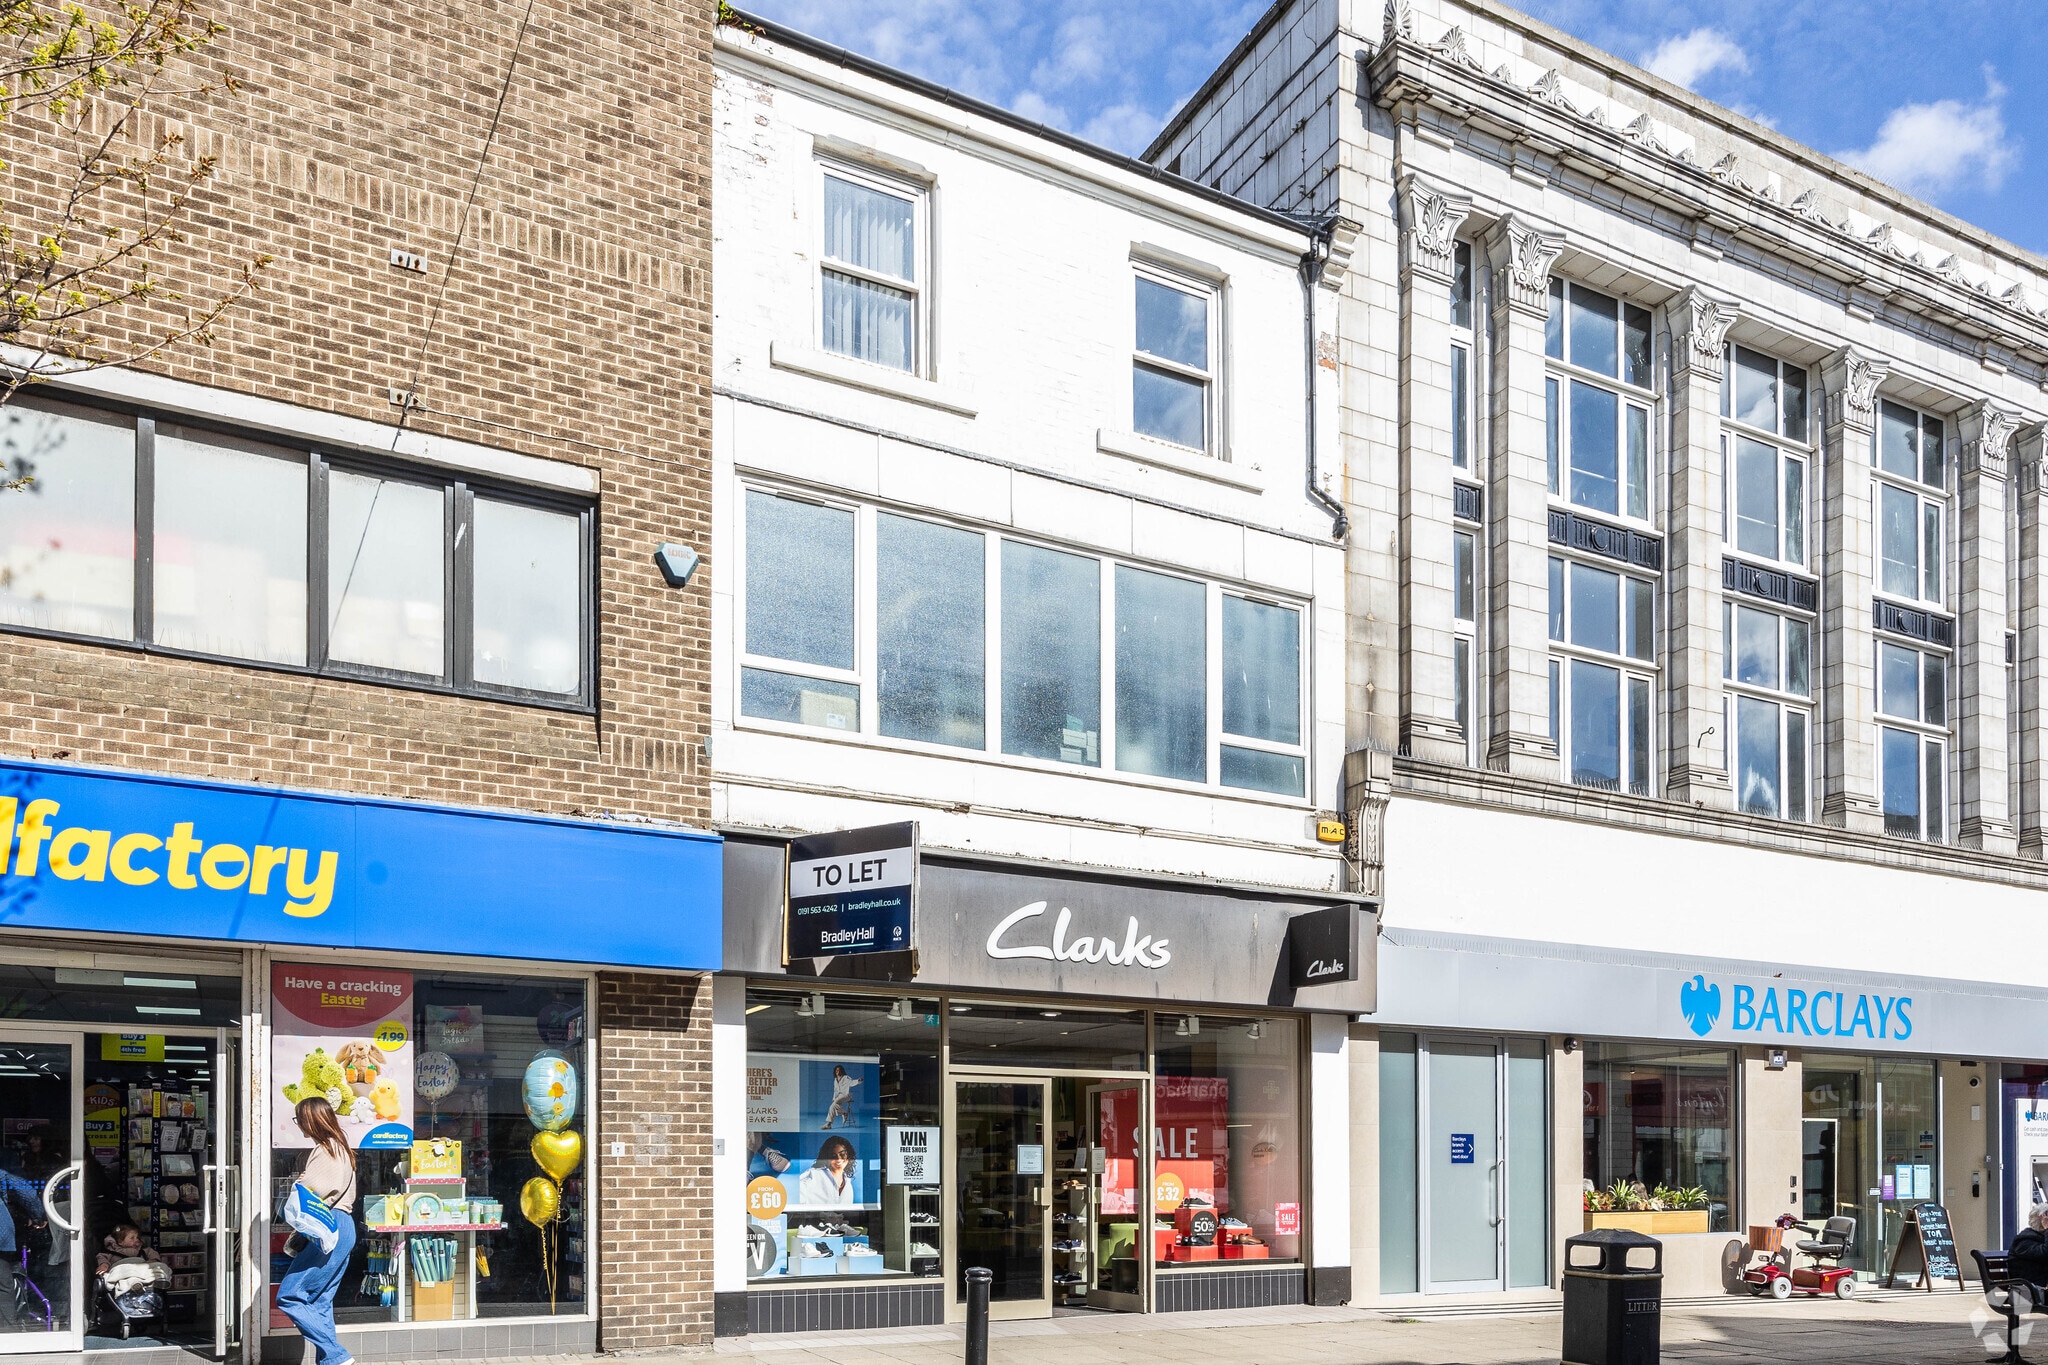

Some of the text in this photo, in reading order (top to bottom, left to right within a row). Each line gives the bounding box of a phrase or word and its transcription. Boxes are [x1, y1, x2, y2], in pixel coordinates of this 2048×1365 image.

[813, 858, 887, 887] TO LET
[798, 897, 901, 916] 0191 563 4242 bradleyhall.co.uk
[986, 901, 1171, 969] Clarks
[1306, 958, 1345, 978] Clarks
[285, 976, 402, 997] Have a cracking
[321, 992, 367, 1006] Easter
[1732, 984, 1913, 1041] BARCLAYS
[377, 1031, 405, 1042] £1.99
[416, 1061, 449, 1075] Happy
[418, 1075, 451, 1088] Easter!
[749, 1077, 778, 1087] BETTER
[89, 1096, 114, 1106] KIDS
[2033, 1111, 2048, 1121] BAR
[85, 1122, 104, 1132] Buy
[900, 1131, 927, 1146] WIN
[1281, 1213, 1295, 1221] SALE
[1194, 1221, 1215, 1232] 50%
[1926, 1230, 1942, 1238] TOM
[747, 1242, 766, 1269] V
[1628, 1302, 1658, 1312] LITTER
